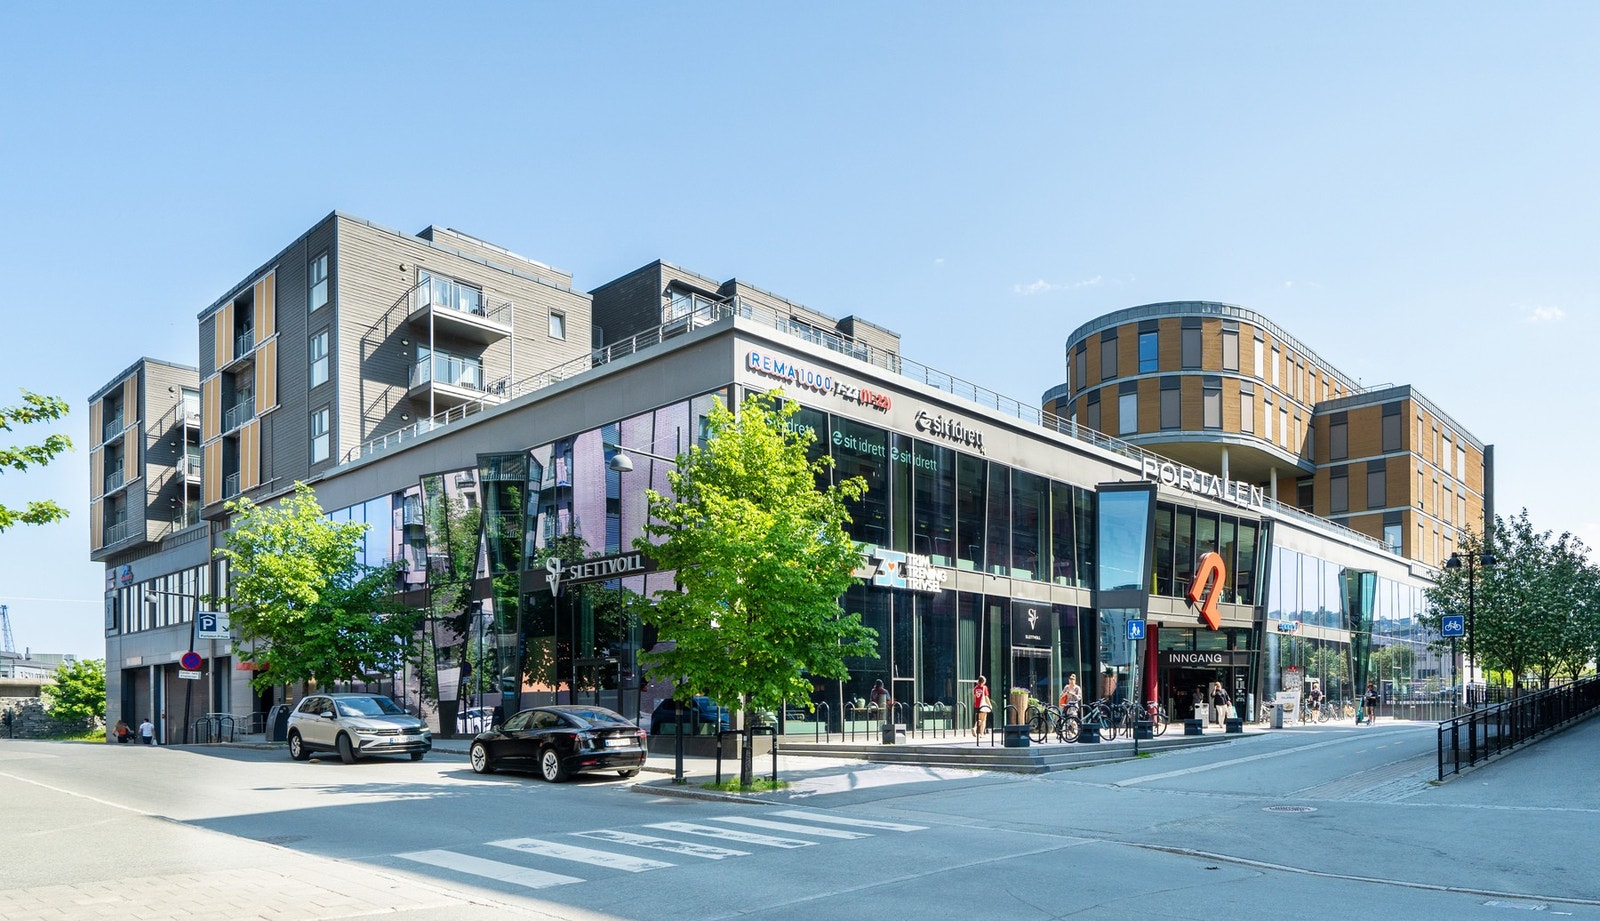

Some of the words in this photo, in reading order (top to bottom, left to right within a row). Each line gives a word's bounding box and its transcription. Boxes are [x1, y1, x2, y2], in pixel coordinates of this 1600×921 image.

[750, 350, 797, 380] REMA
[800, 367, 832, 391] 1000
[933, 414, 951, 437] sit
[951, 418, 984, 446] idrett
[844, 434, 858, 450] sit
[858, 437, 886, 458] idrett
[900, 450, 912, 465] sit
[912, 452, 938, 472] idrett
[1143, 456, 1264, 507] PORTALEN
[570, 554, 645, 580] SLETTVOLL
[907, 552, 931, 568] TRIM
[1169, 653, 1222, 663] INNGANG
